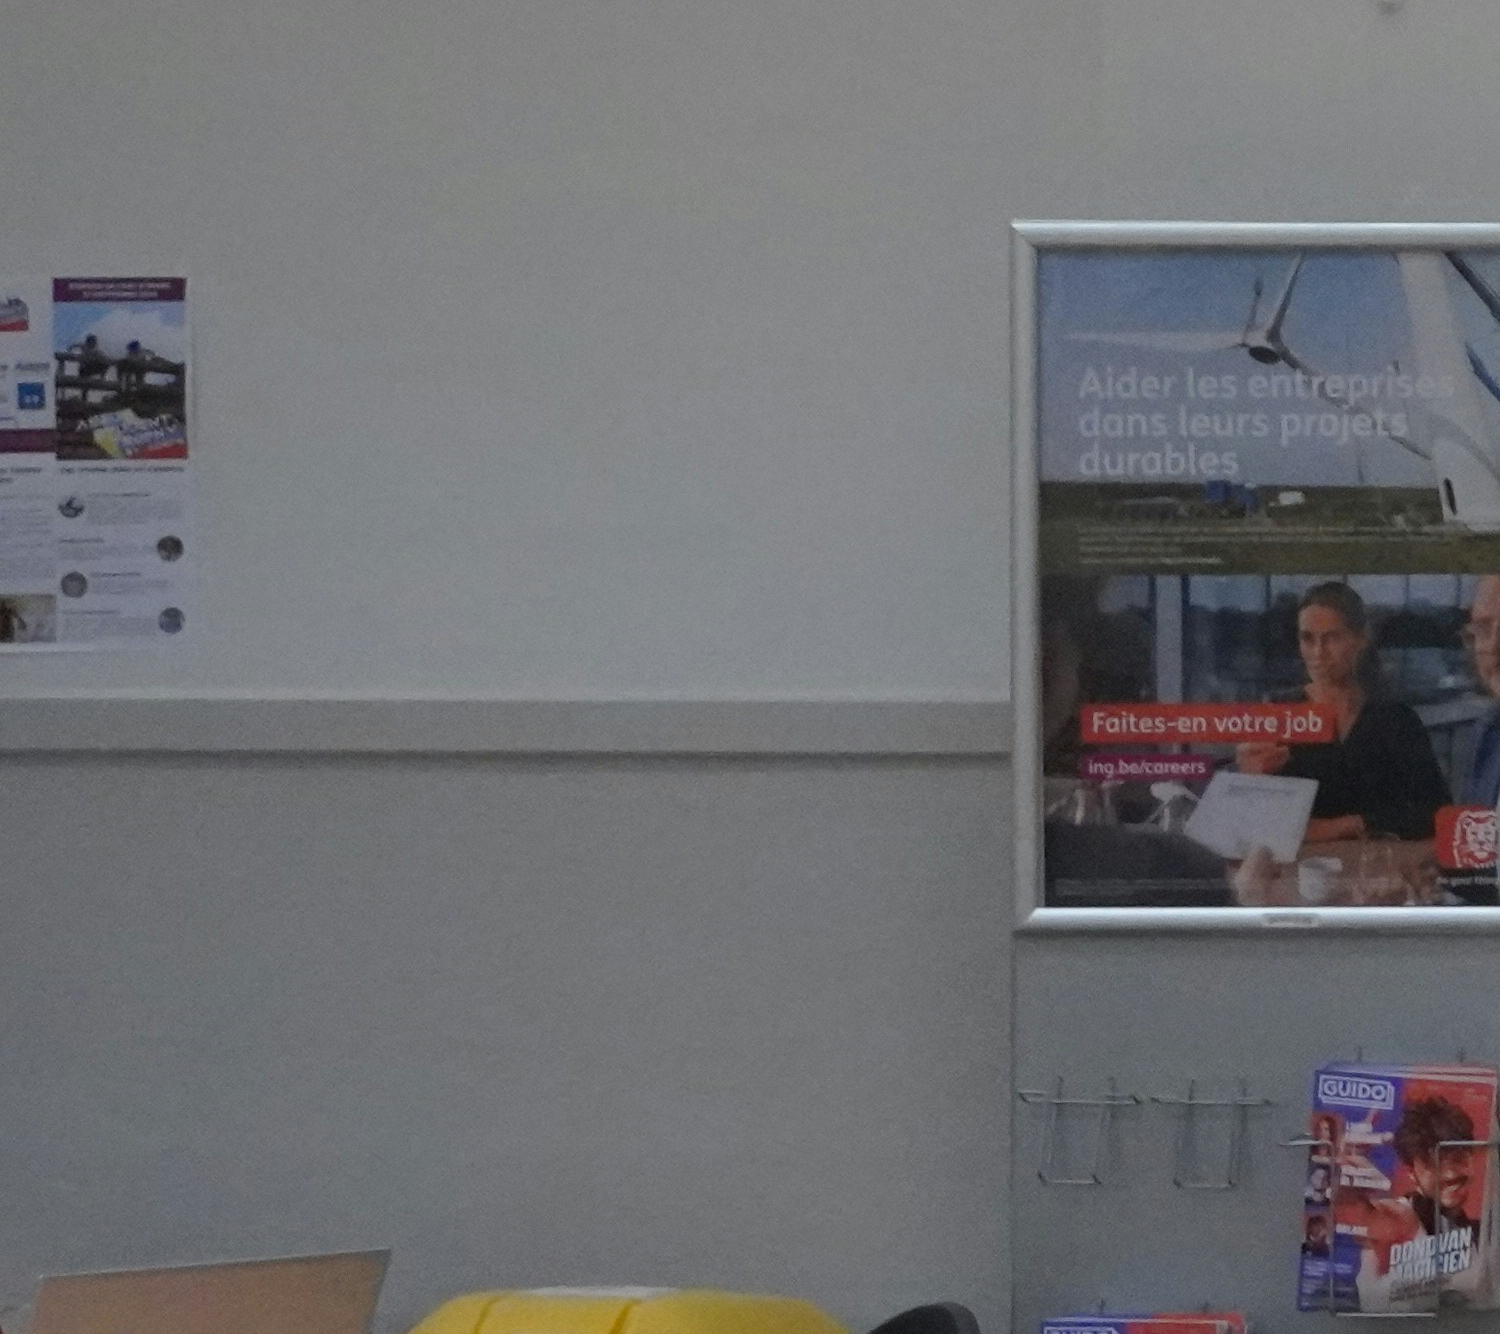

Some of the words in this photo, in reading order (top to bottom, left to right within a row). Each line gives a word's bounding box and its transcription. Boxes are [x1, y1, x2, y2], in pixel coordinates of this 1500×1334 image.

[1078, 367, 1178, 399] Aider
[1186, 367, 1238, 399] les
[1249, 366, 1455, 405] entreprises
[1078, 405, 1168, 438] dans
[1179, 404, 1268, 438] leurs
[1280, 407, 1409, 446] projets
[1078, 441, 1240, 476] durables
[1092, 711, 1207, 734] Faites-en
[1214, 713, 1277, 733] votre
[1283, 710, 1323, 738] job
[1323, 1079, 1387, 1100] GUIDO
